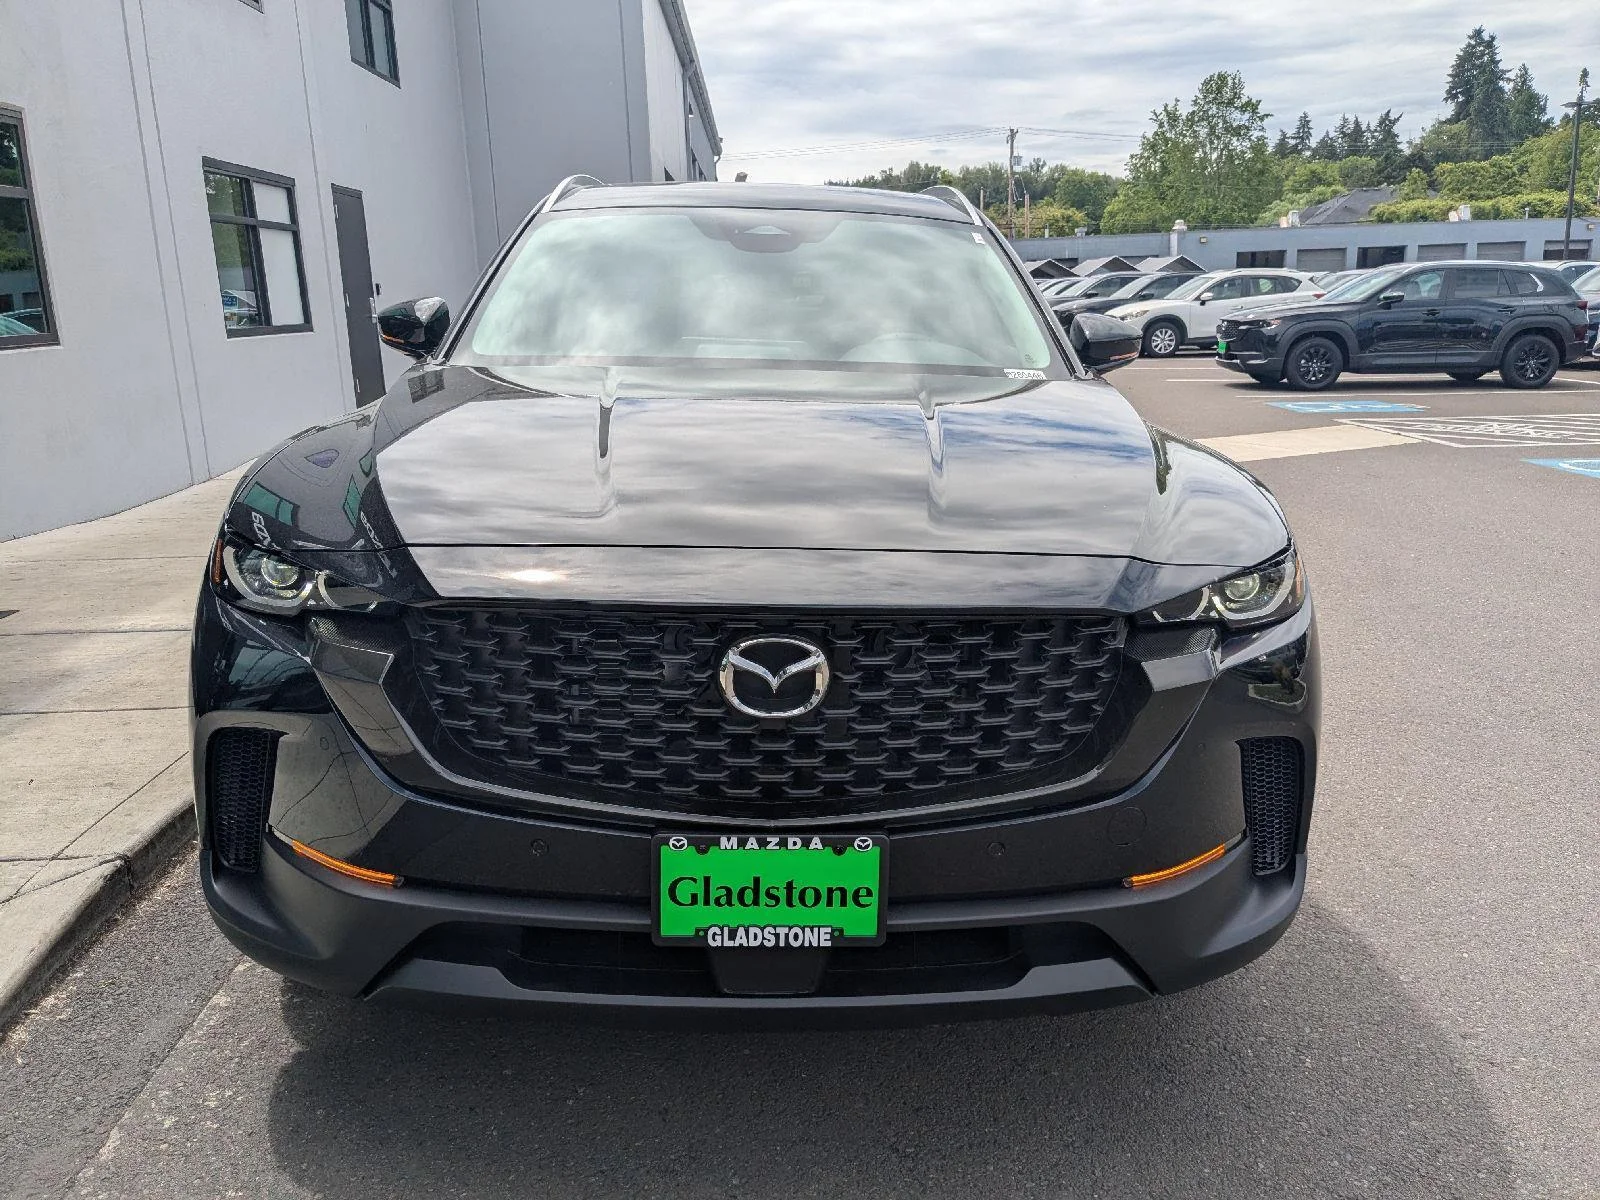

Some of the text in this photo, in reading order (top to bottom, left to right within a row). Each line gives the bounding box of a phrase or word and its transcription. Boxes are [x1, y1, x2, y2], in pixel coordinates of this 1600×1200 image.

[719, 836, 824, 850] MAZDA
[667, 875, 874, 909] Gladstone
[707, 926, 832, 948] GLADSTONE
